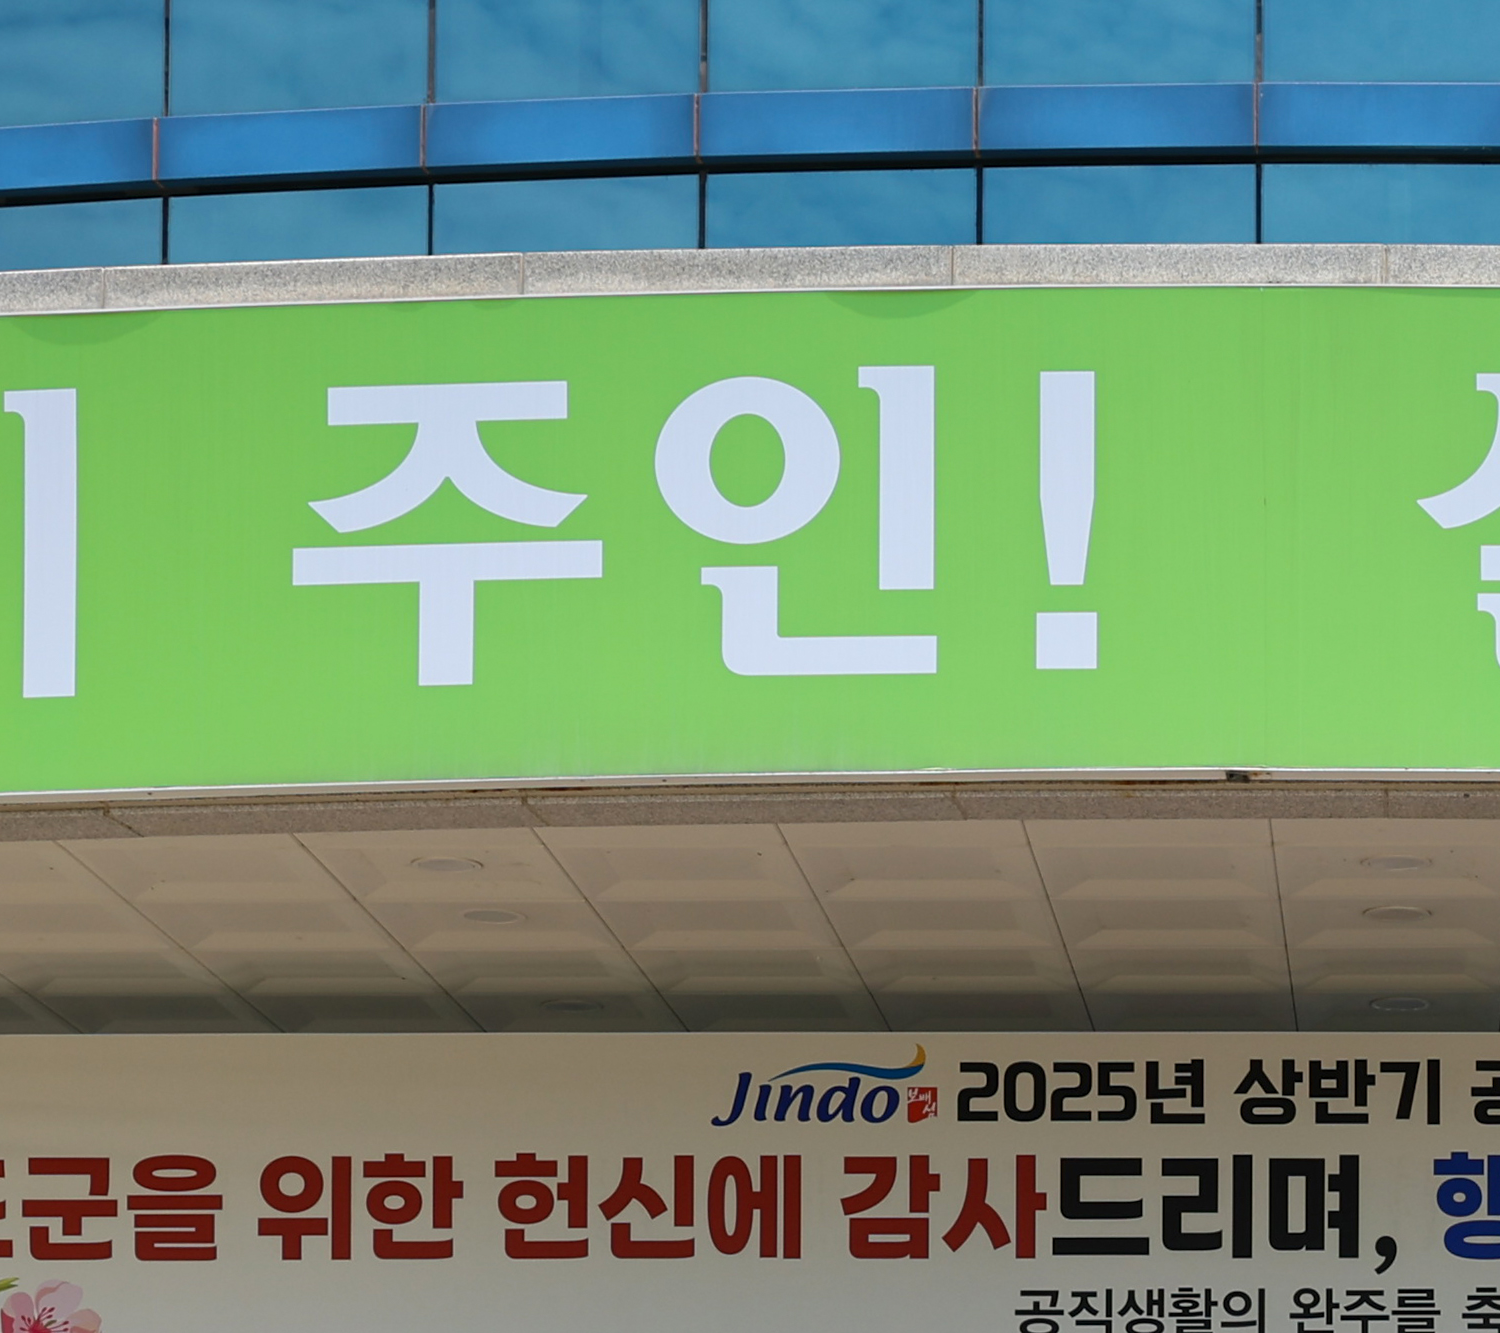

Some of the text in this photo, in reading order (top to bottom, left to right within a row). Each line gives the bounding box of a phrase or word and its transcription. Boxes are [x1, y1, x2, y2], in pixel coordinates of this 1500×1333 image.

[292, 365, 1099, 686] 주인!
[711, 1071, 900, 1126] Jindo
[957, 1059, 1205, 1125] 2025년
[1234, 1059, 1440, 1125] 상반기
[258, 1154, 463, 1261] 위한
[495, 1153, 801, 1260] 헌신에
[841, 1153, 1397, 1273] 감사드리며,
